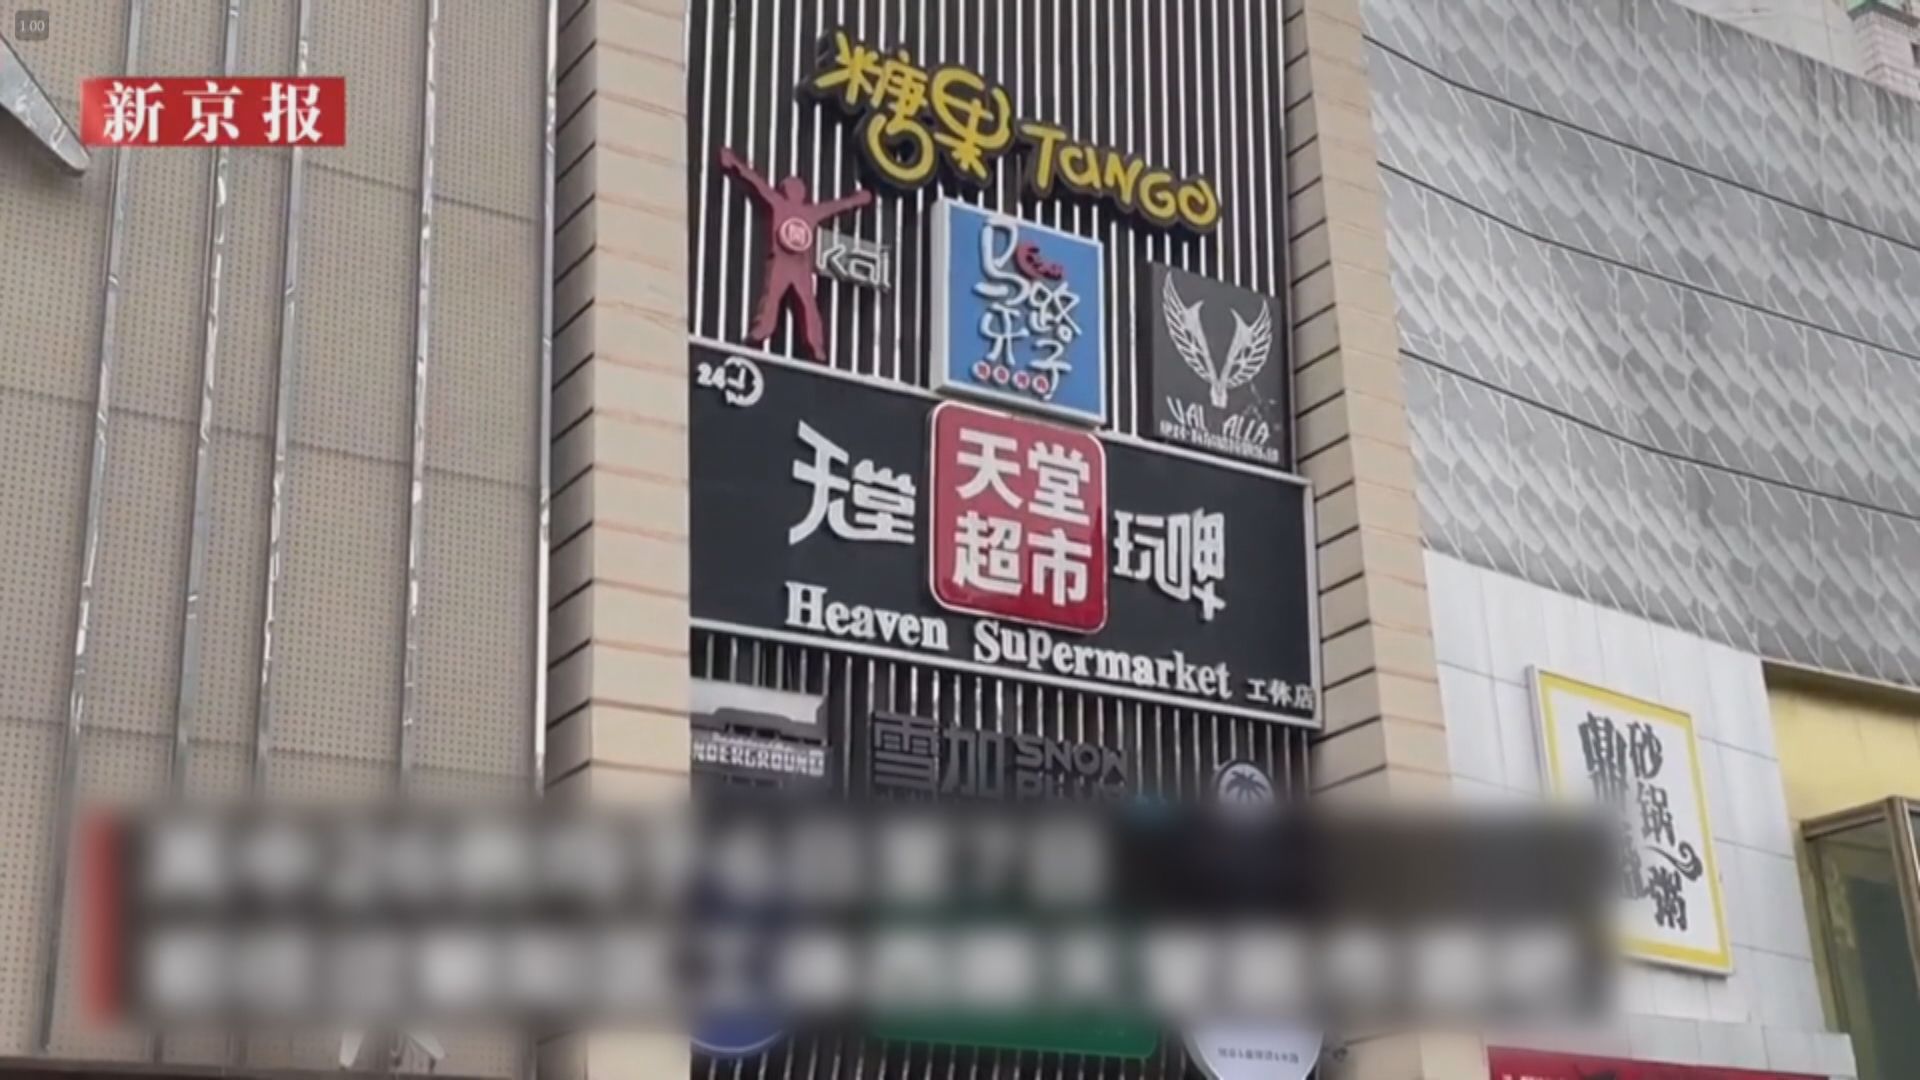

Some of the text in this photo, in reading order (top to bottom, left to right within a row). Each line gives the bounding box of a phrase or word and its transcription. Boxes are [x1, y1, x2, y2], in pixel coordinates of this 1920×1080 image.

[815, 32, 1012, 182] 糖果
[697, 361, 726, 389] 24
[788, 419, 917, 545] 天堂
[955, 427, 1091, 527] 天堂
[952, 510, 1093, 608] 超市
[784, 581, 1233, 699] Heaven Supermarket
[692, 740, 825, 777] NDERGROUND
[873, 710, 1004, 797] 雪加
[1013, 733, 1128, 786] SNOW
